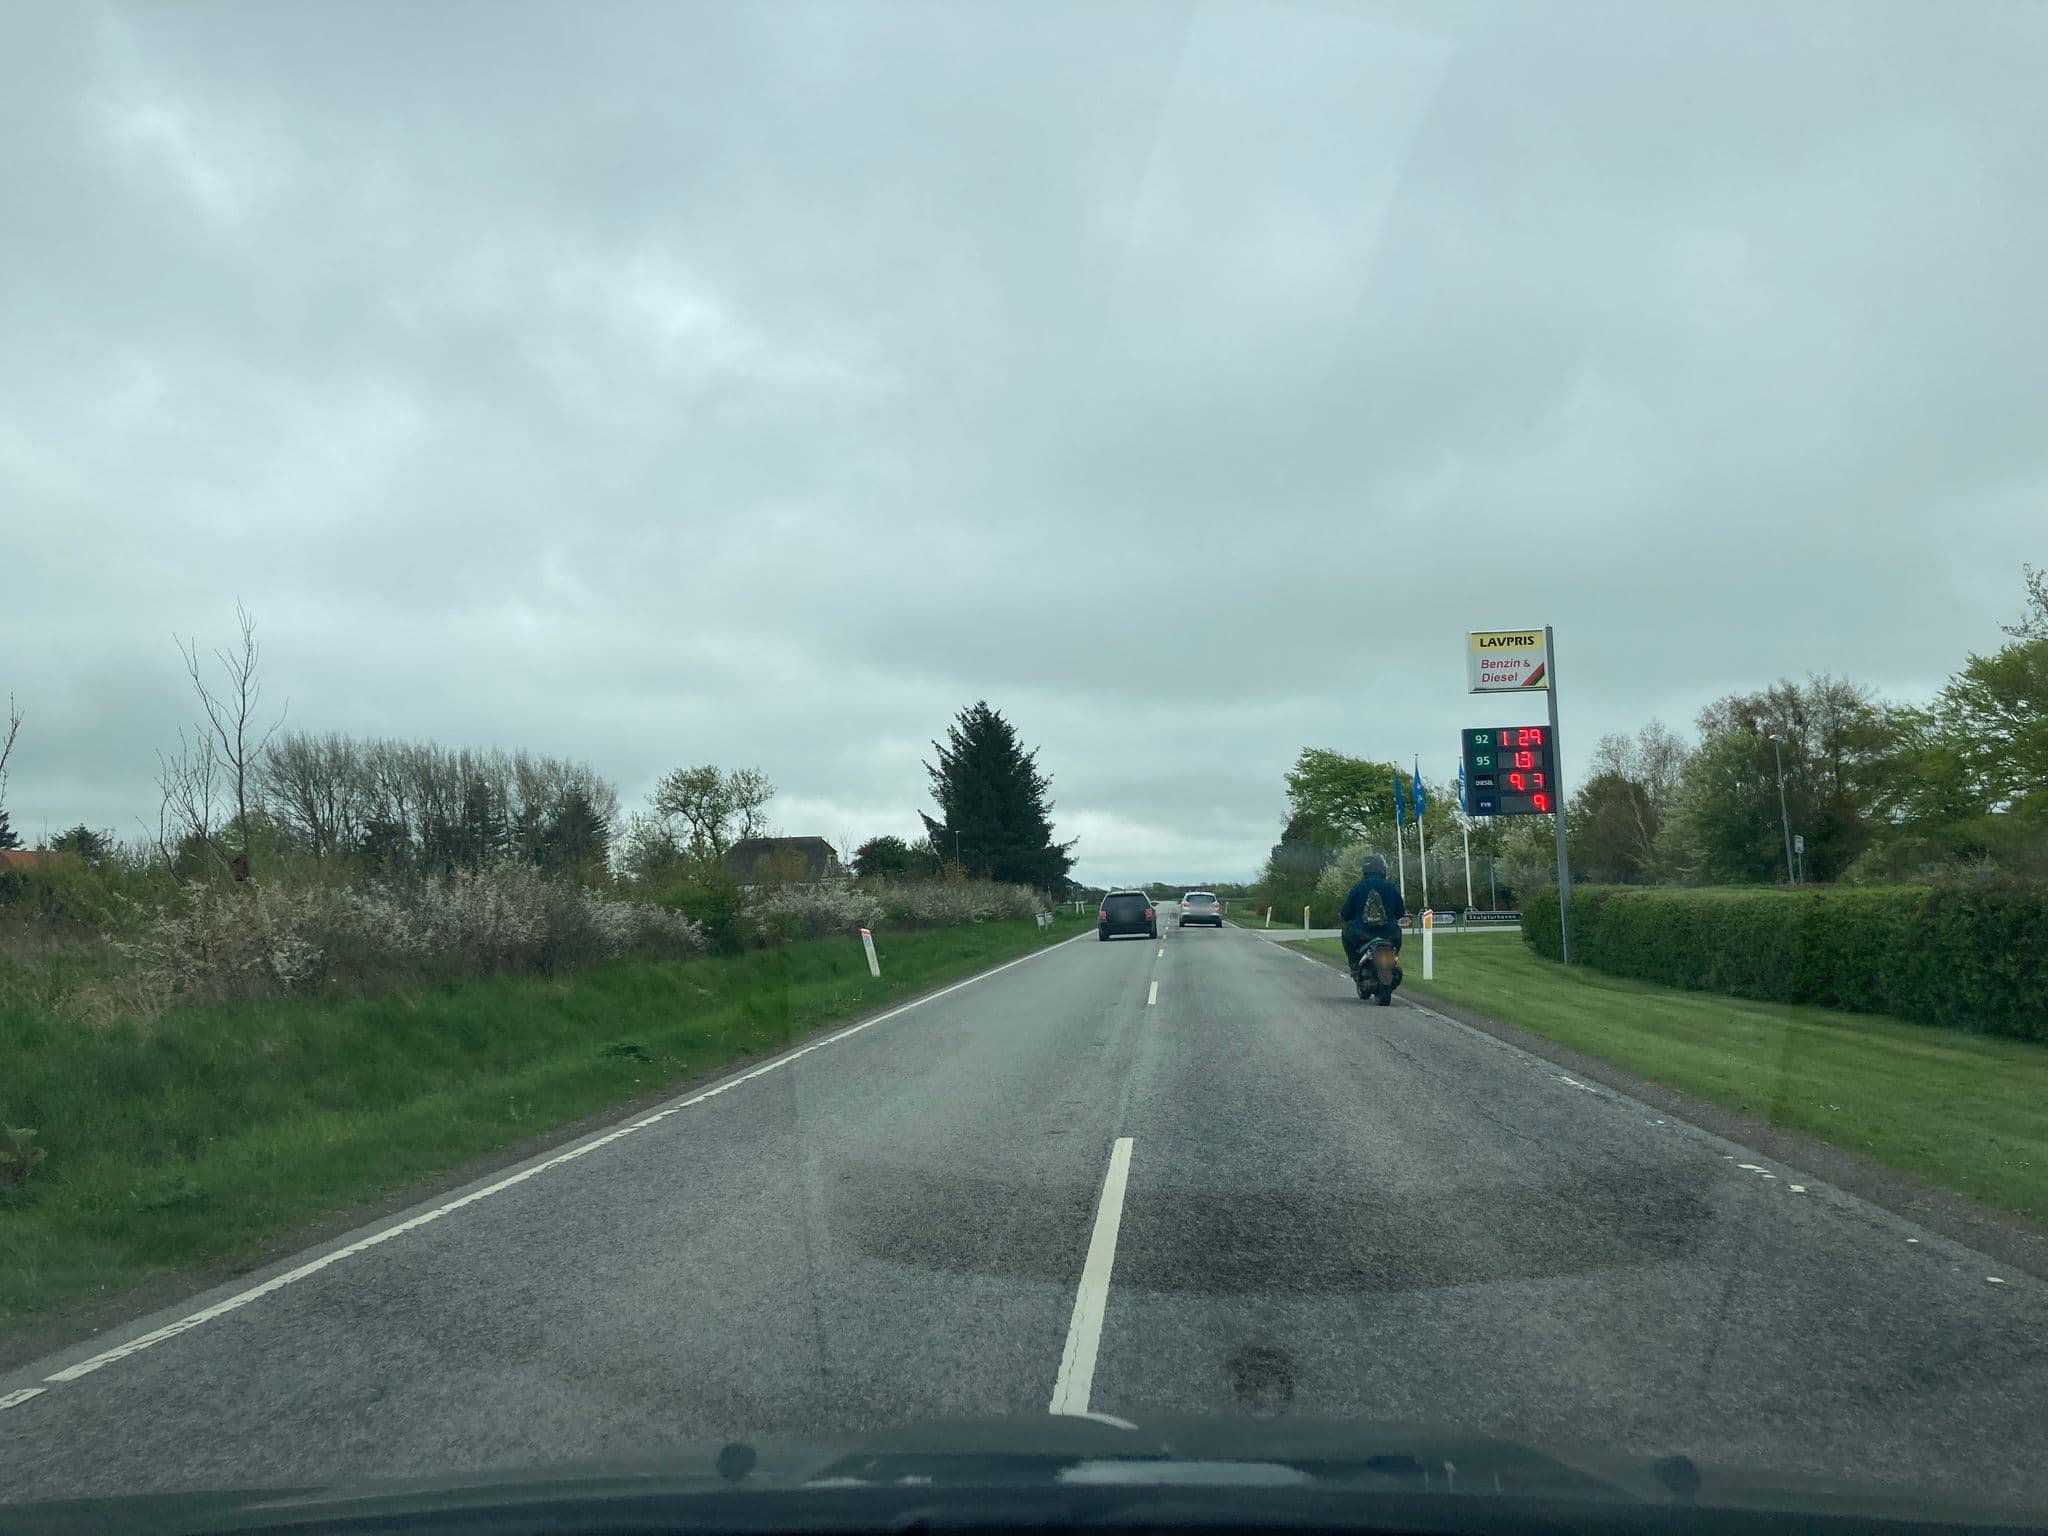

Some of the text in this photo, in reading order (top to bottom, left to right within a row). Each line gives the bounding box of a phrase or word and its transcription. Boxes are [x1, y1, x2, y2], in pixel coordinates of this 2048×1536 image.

[1480, 636, 1535, 648] LAVPRIS
[1481, 659, 1531, 669] Benzin &
[1482, 672, 1518, 683] Diesel
[1475, 734, 1489, 744] 92
[1476, 756, 1490, 766] 95
